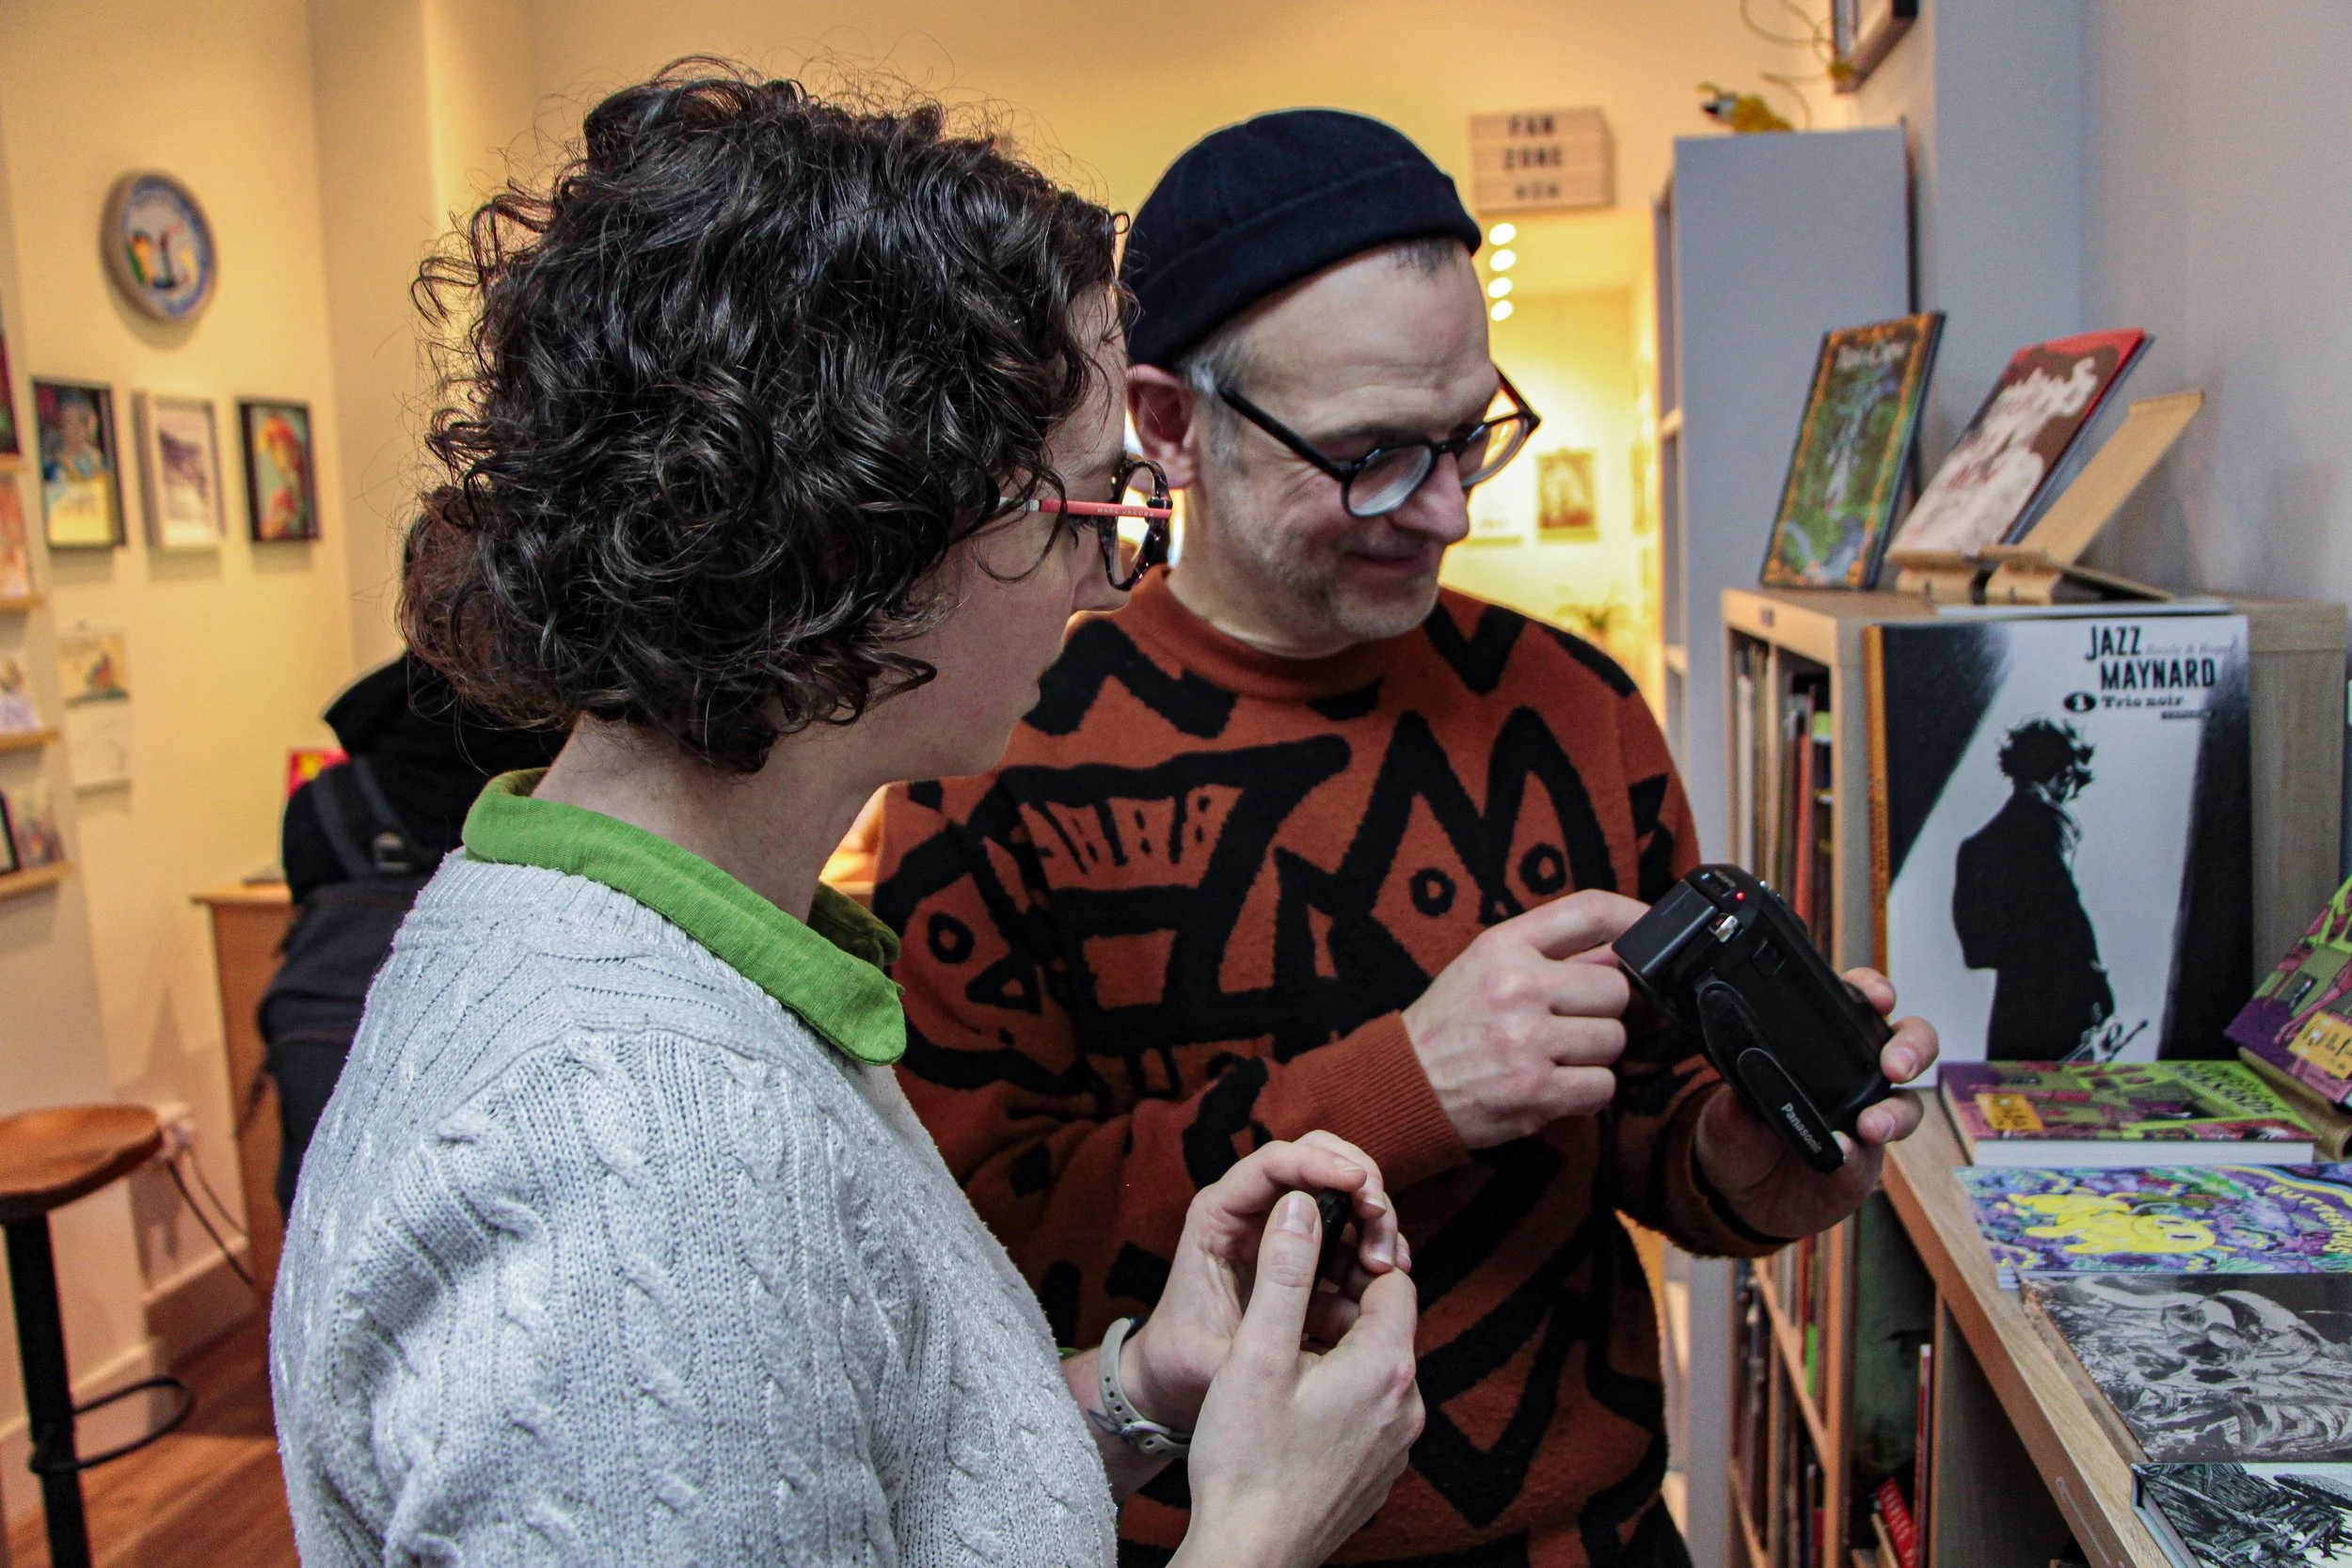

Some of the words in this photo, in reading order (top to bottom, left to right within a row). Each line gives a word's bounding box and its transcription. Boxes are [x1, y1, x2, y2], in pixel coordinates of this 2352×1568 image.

[2085, 625, 2141, 661] JAZZ
[2100, 657, 2217, 690] MAYNARD
[2101, 693, 2143, 708] Trio
[2146, 692, 2184, 707] noir
[1780, 1101, 1823, 1155] Panasonic
